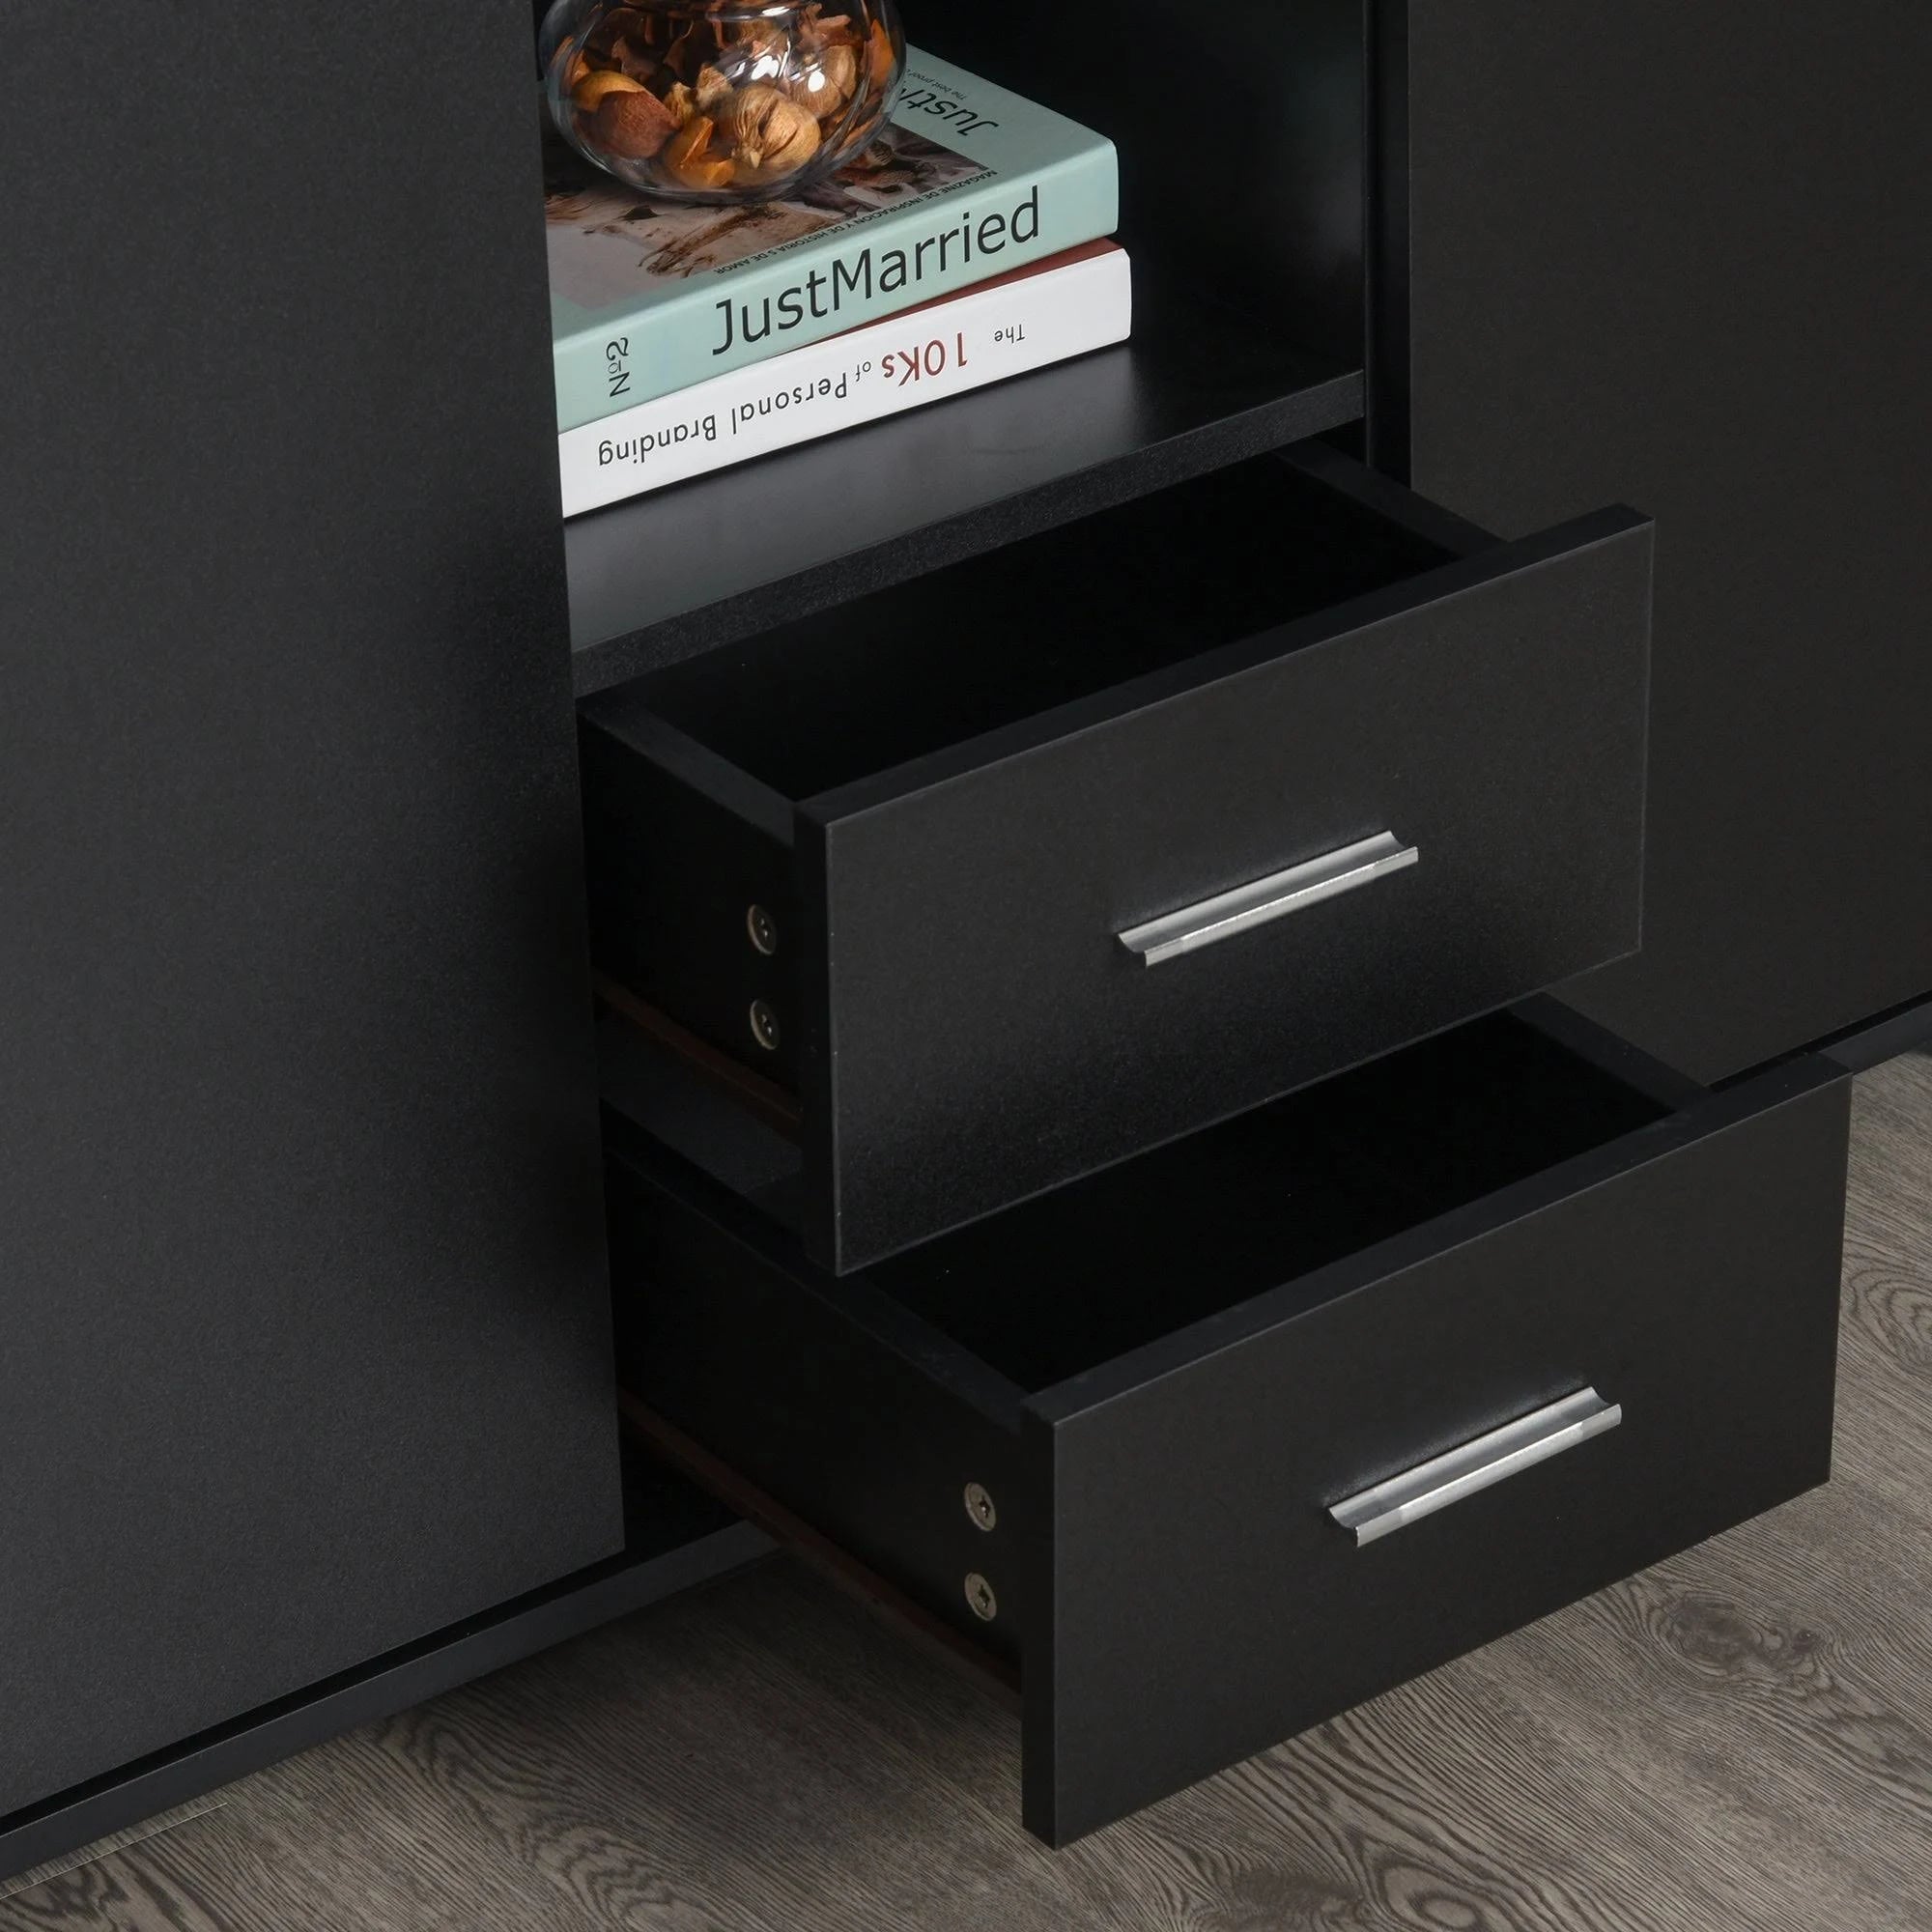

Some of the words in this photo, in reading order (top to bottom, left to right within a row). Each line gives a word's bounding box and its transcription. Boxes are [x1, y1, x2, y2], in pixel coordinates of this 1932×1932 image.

[939, 170, 998, 194] MAGAZINE
[923, 192, 940, 201] DE
[829, 225, 845, 235] DE
[713, 258, 751, 274] AMOR
[751, 253, 769, 262] DE
[712, 185, 1039, 355] JustMarried
[993, 324, 1026, 344] The
[881, 332, 968, 386] 10Ks
[855, 361, 871, 382] of
[731, 373, 847, 435] Personal
[598, 414, 717, 466] Branding
